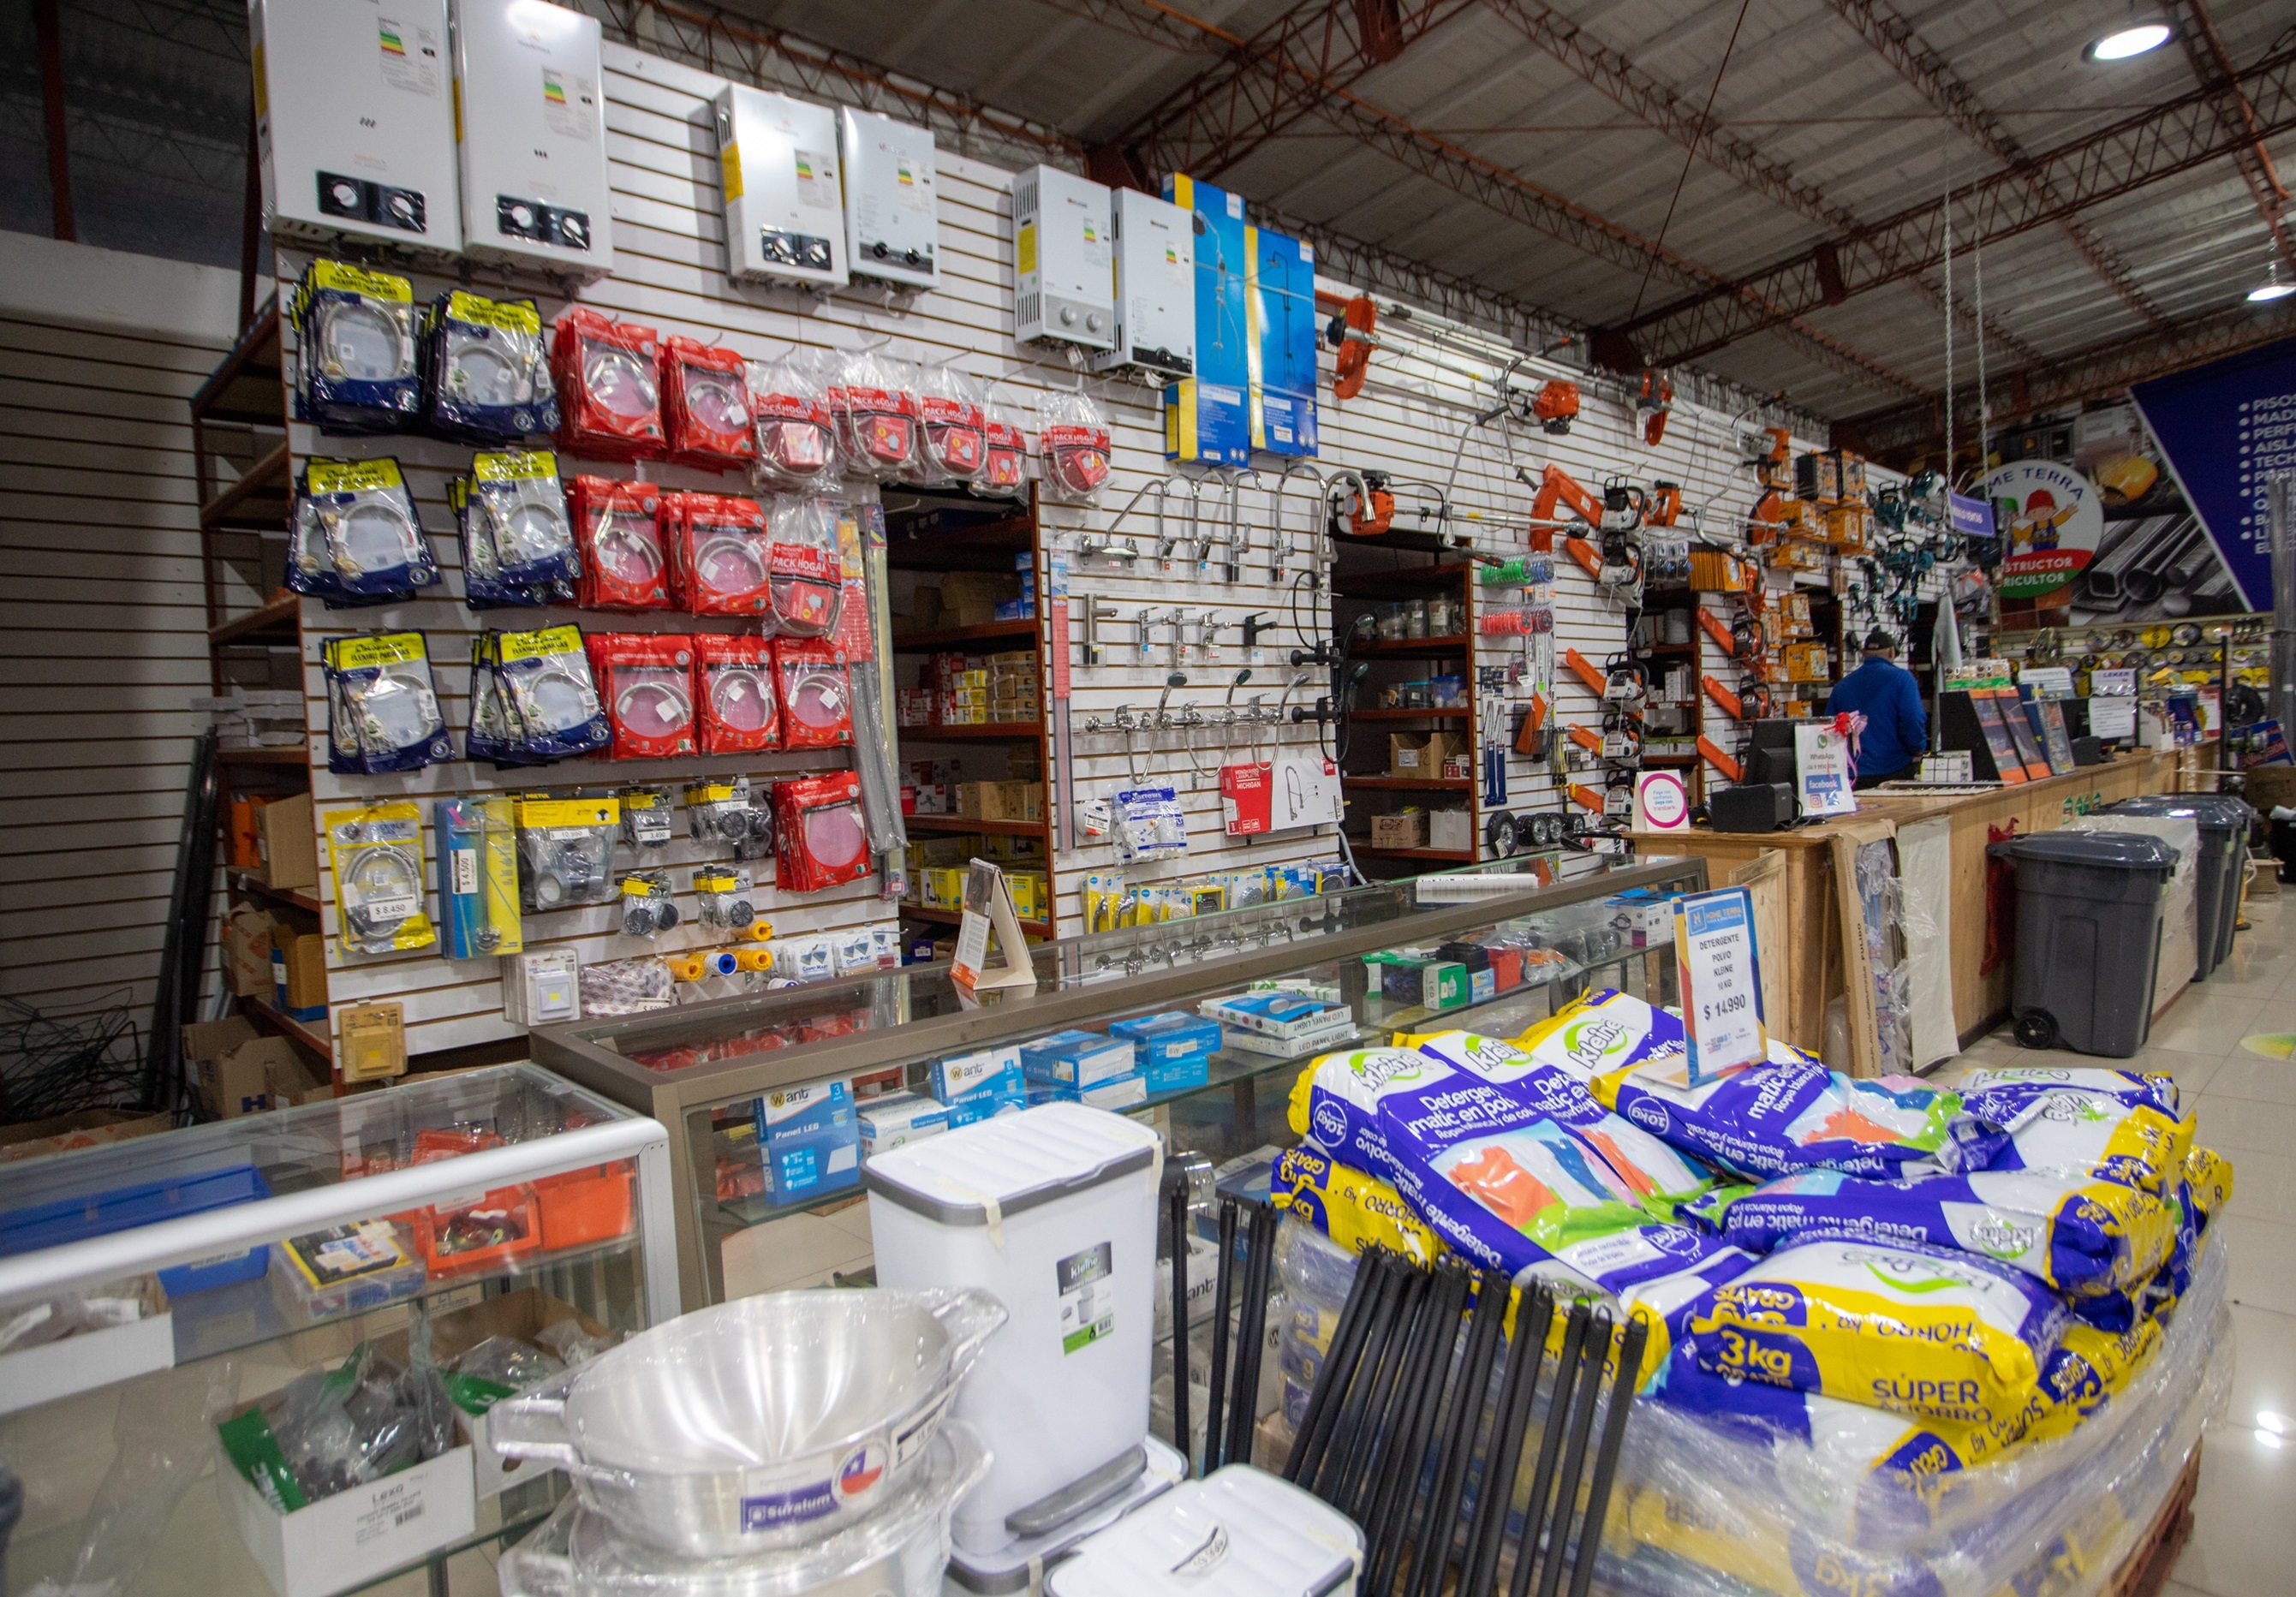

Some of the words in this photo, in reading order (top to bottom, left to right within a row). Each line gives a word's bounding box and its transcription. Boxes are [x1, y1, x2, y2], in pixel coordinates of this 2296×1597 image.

[2022, 468, 2084, 502] TERRA
[772, 556, 796, 567] PACK
[2004, 557, 2072, 573] STRUCTOR
[2004, 573, 2066, 587] RICULTOR
[1237, 781, 1261, 790] MICHIGAN
[1809, 780, 1838, 789] facebook
[383, 904, 406, 915] 8.450
[1699, 933, 1740, 950] DETERGENTE
[1857, 922, 1866, 961] PULIDO
[1712, 950, 1732, 962] POLVO
[1703, 1004, 1711, 1021] $
[1715, 994, 1745, 1017] 14.990
[1313, 1015, 1331, 1026] PANEL
[1332, 1012, 1345, 1021] LED
[1294, 1022, 1312, 1032] LIGHT
[1298, 1041, 1310, 1052] LED
[1311, 1036, 1330, 1048] PANEL
[1331, 1031, 1348, 1041] LIGHT
[1569, 1018, 1625, 1070] kleine
[1005, 1061, 1012, 1070] 6
[833, 1084, 840, 1096] 3
[953, 1093, 977, 1105] Panel
[979, 1089, 992, 1099] LED
[1458, 1105, 1484, 1123] en
[1485, 1093, 1520, 1121] polv
[1315, 1109, 1345, 1137] 10kg
[775, 1126, 802, 1141] Panel
[803, 1123, 820, 1133] LED
[1744, 1214, 1764, 1228] en
[1425, 1204, 1502, 1268] Detergente
[1720, 1330, 1792, 1377] 3kg
[1871, 1374, 1980, 1406] SÚPER
